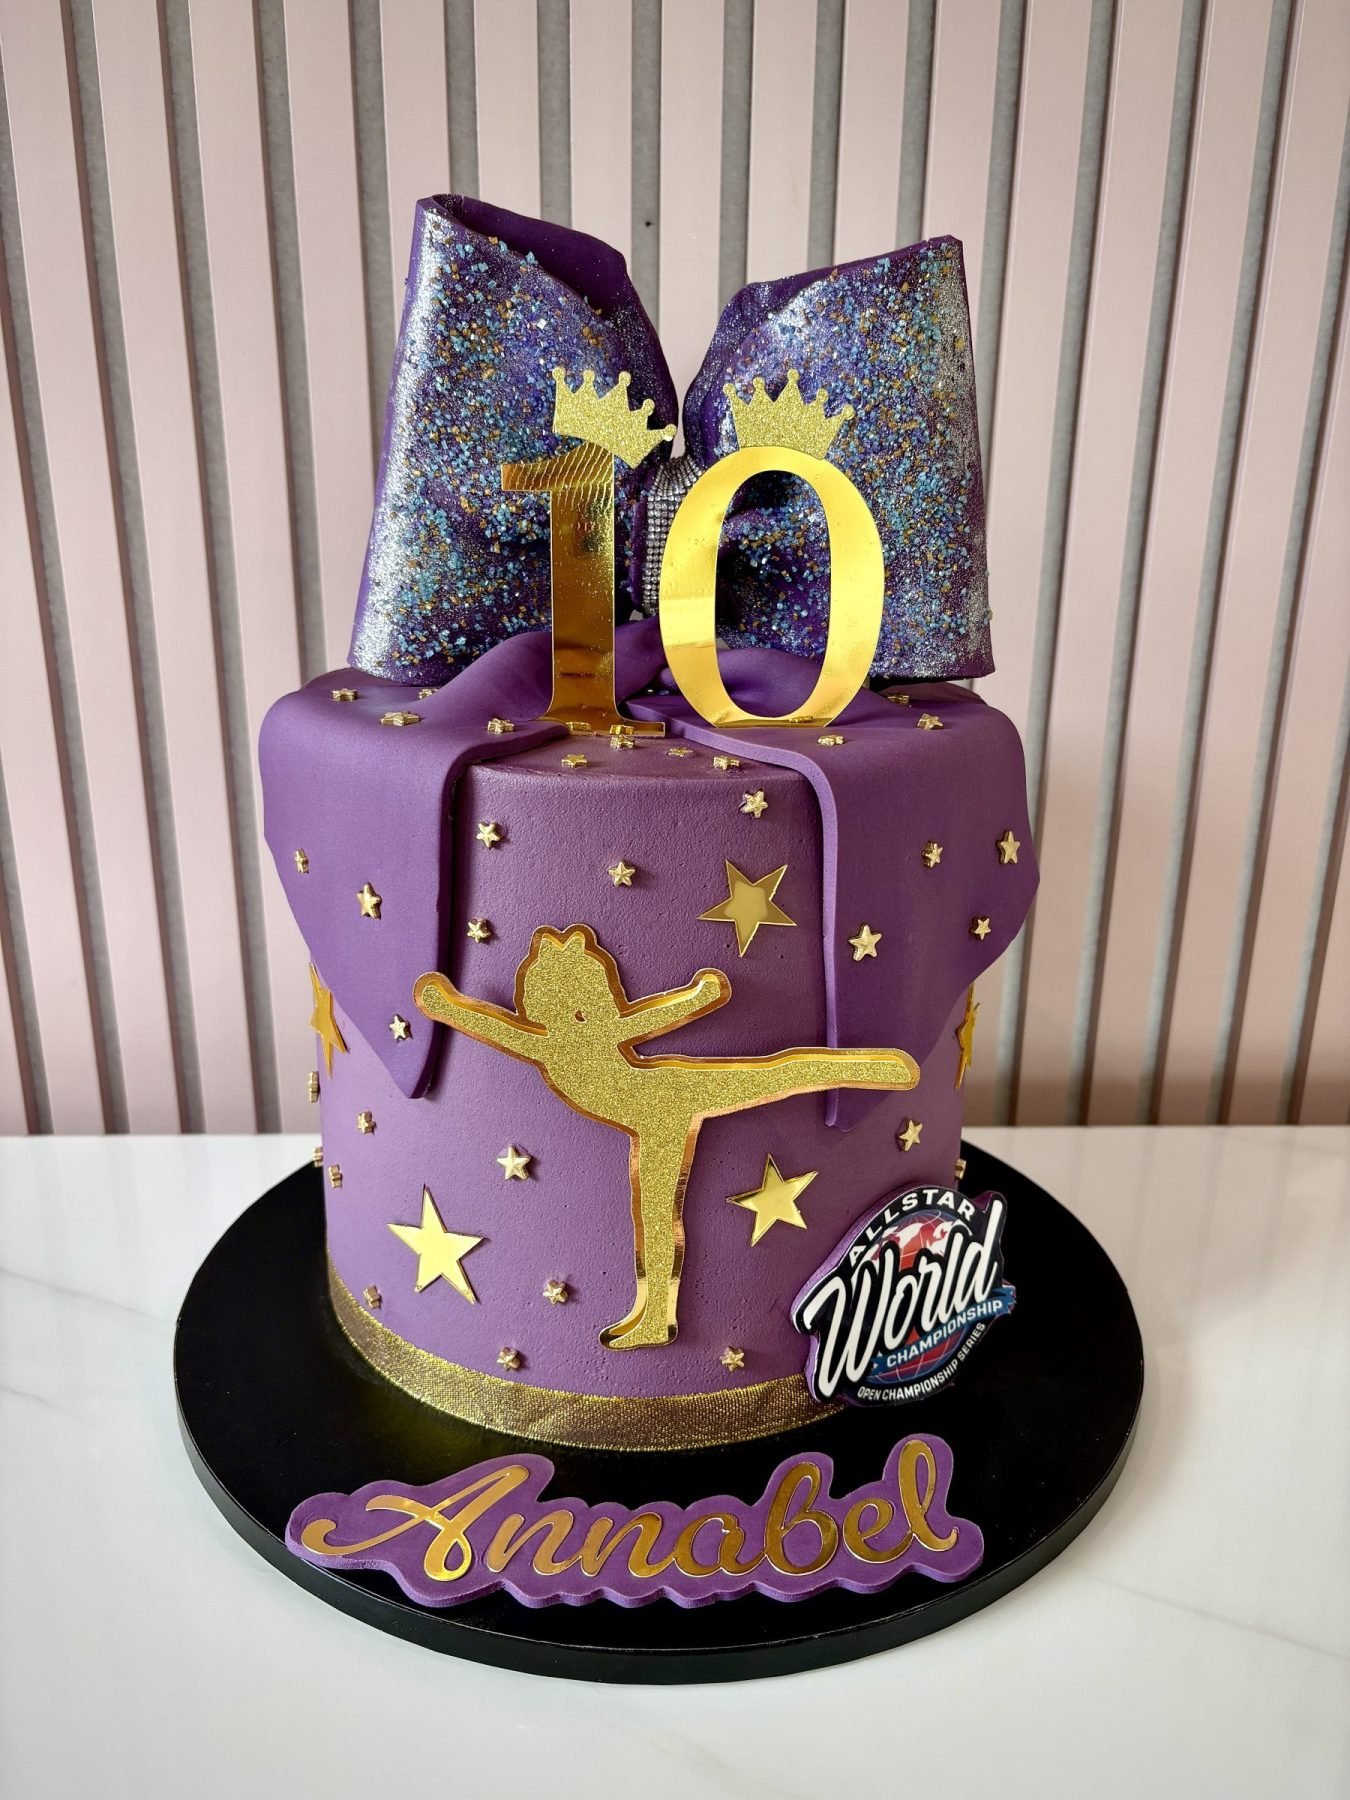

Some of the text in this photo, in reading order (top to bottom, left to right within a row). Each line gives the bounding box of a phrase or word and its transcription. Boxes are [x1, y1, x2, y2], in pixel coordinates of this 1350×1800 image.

[501, 442, 885, 737] 10
[849, 1189, 976, 1267] ALLSTAR
[802, 1199, 1003, 1397] World
[886, 1300, 1003, 1368] CHAMPIONSHIP
[857, 1322, 986, 1401] OPEN CHAMPIONSHIP SERIES
[301, 1439, 959, 1580] Annabel
